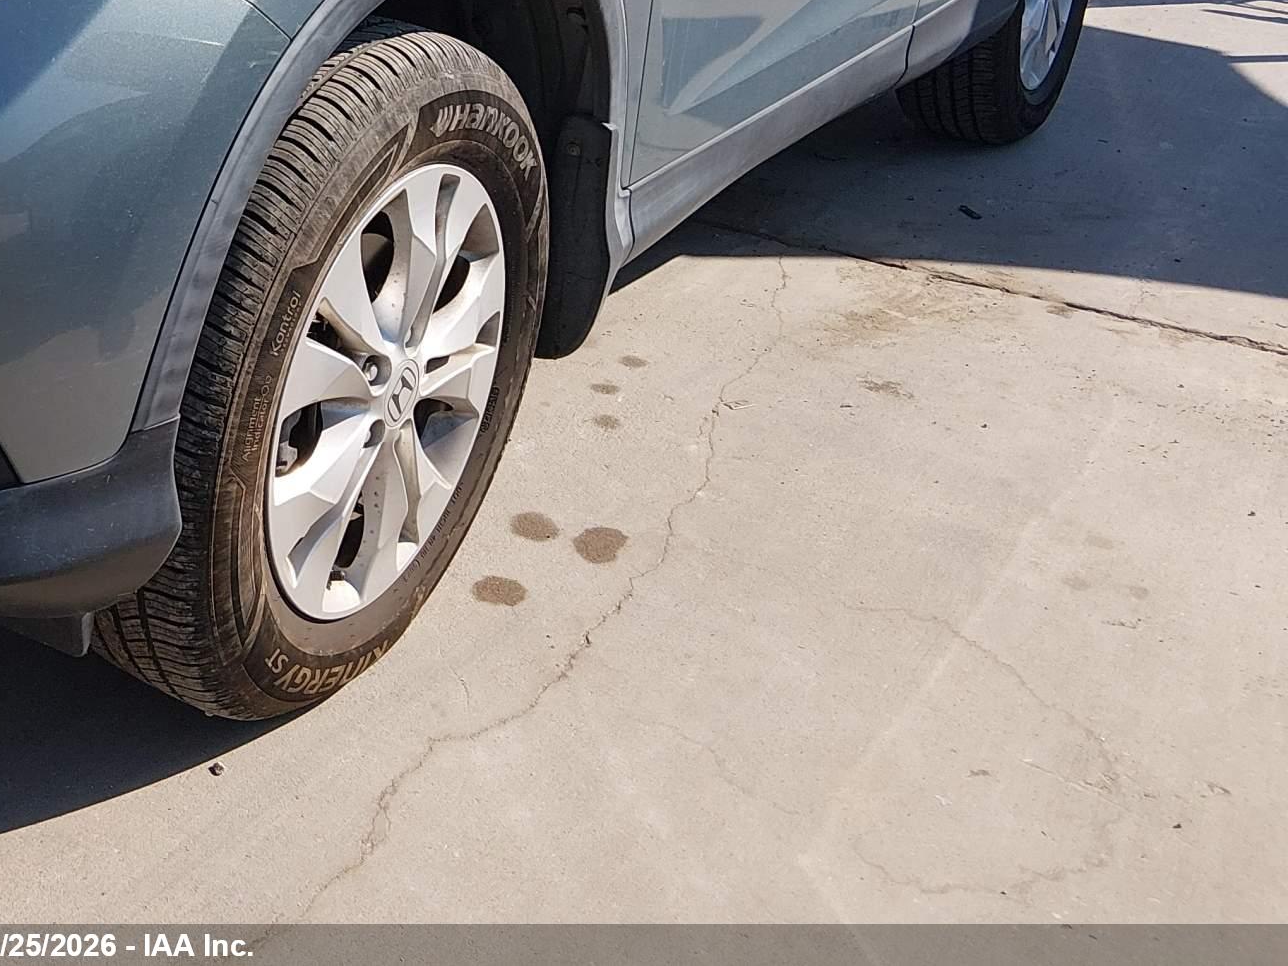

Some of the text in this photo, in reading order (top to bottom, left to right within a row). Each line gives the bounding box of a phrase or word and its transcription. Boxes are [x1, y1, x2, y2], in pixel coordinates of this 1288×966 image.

[270, 290, 302, 356] Kontrol
[241, 397, 263, 462] Alignment
[252, 399, 270, 451] Indicator
[265, 648, 290, 674] ST
